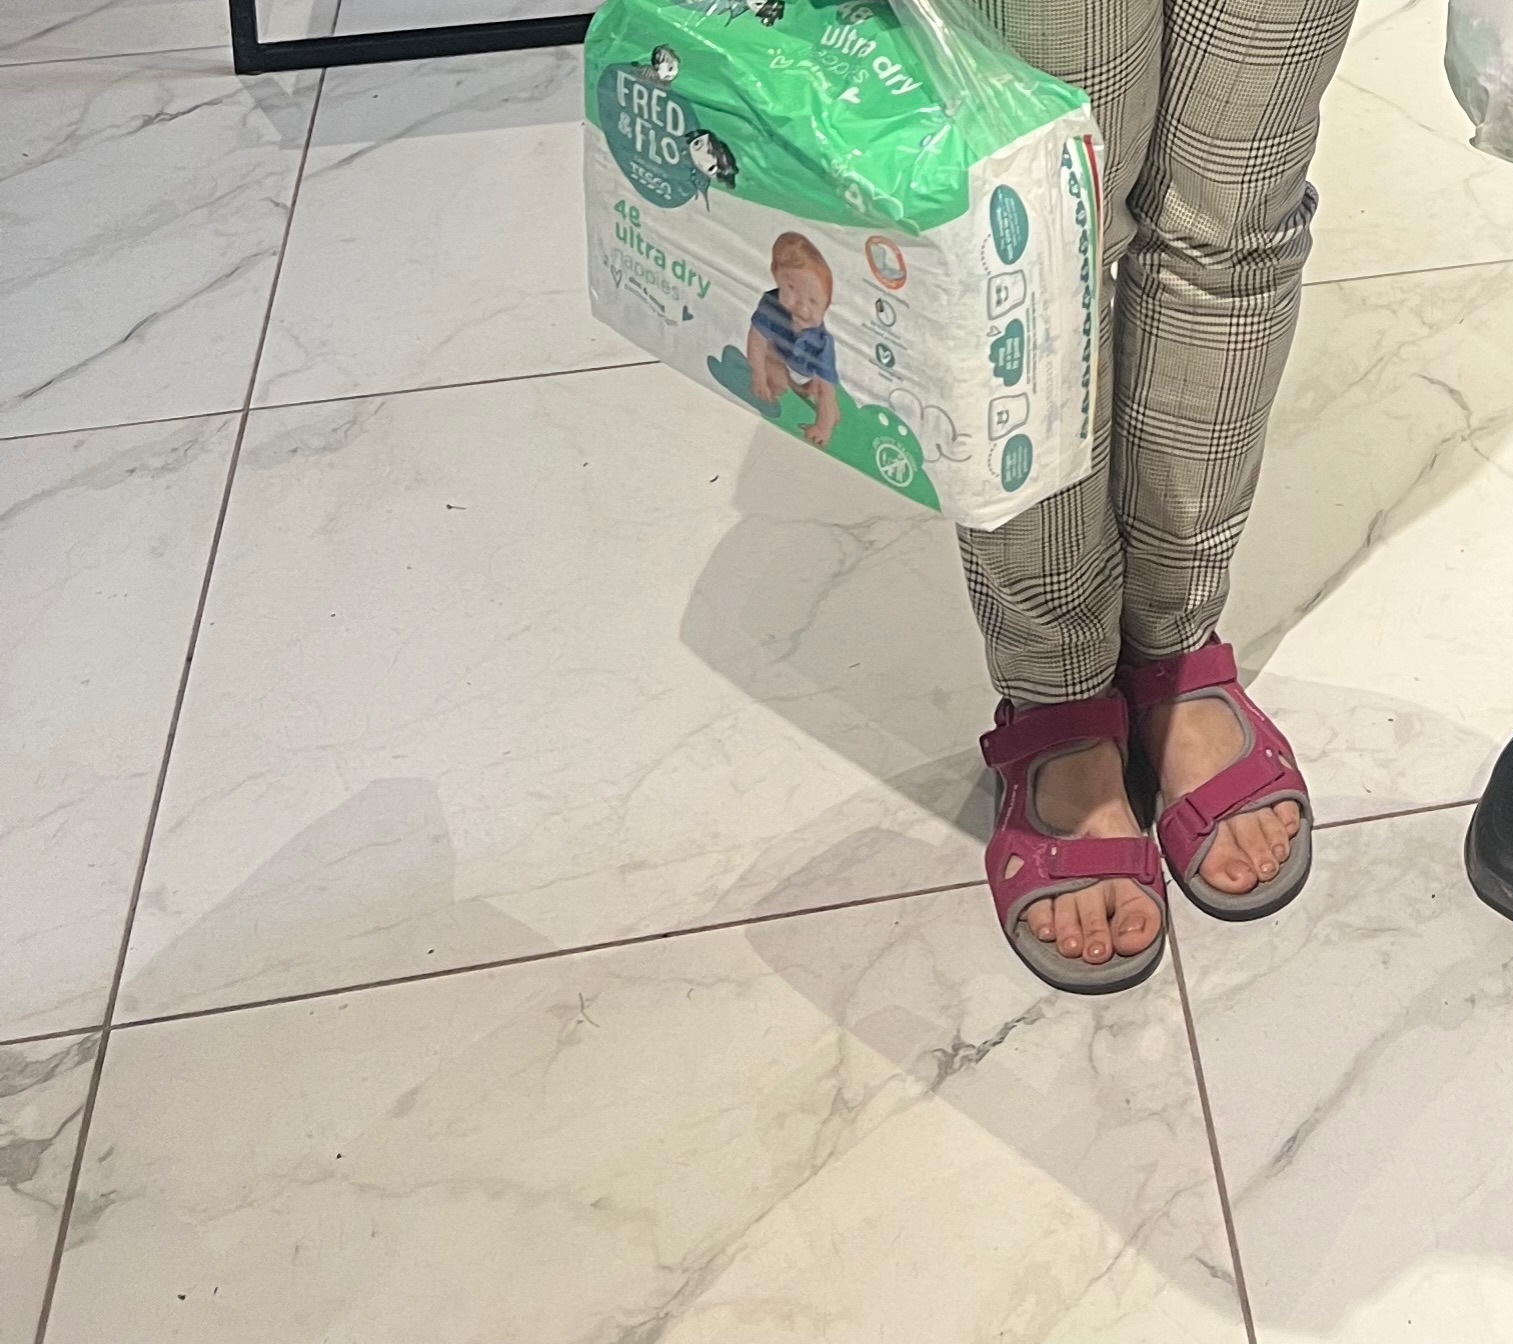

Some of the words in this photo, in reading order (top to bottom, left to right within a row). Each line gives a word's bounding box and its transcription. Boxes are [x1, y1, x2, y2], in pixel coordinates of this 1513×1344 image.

[820, 24, 877, 58] ultra
[872, 55, 924, 95] dry
[616, 70, 686, 137] FRED
[617, 111, 632, 139] &
[634, 116, 680, 165] FLO
[615, 221, 666, 272] ultra
[671, 258, 711, 300] dry
